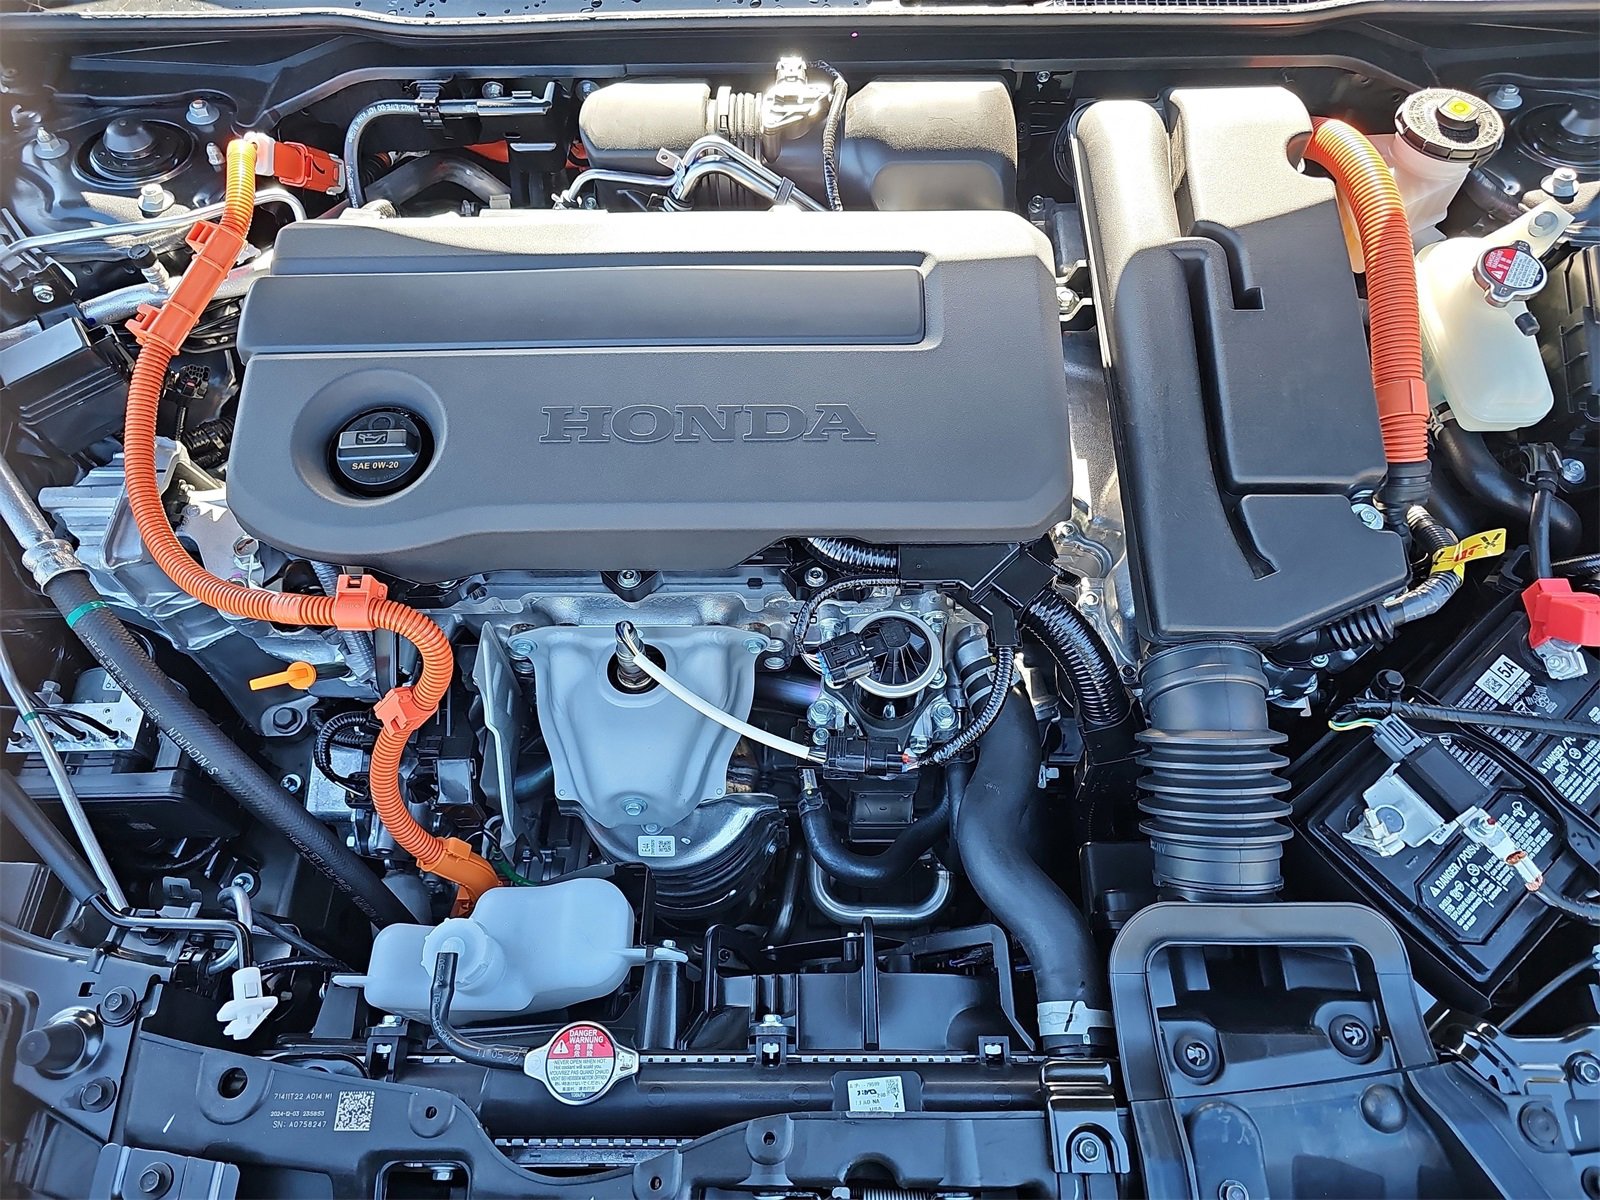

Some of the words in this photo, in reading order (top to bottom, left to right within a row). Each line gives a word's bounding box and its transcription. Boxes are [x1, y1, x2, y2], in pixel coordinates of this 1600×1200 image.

[539, 404, 876, 443] HONDA
[1496, 658, 1517, 679] 5A
[166, 727, 210, 768] NICHIRIN
